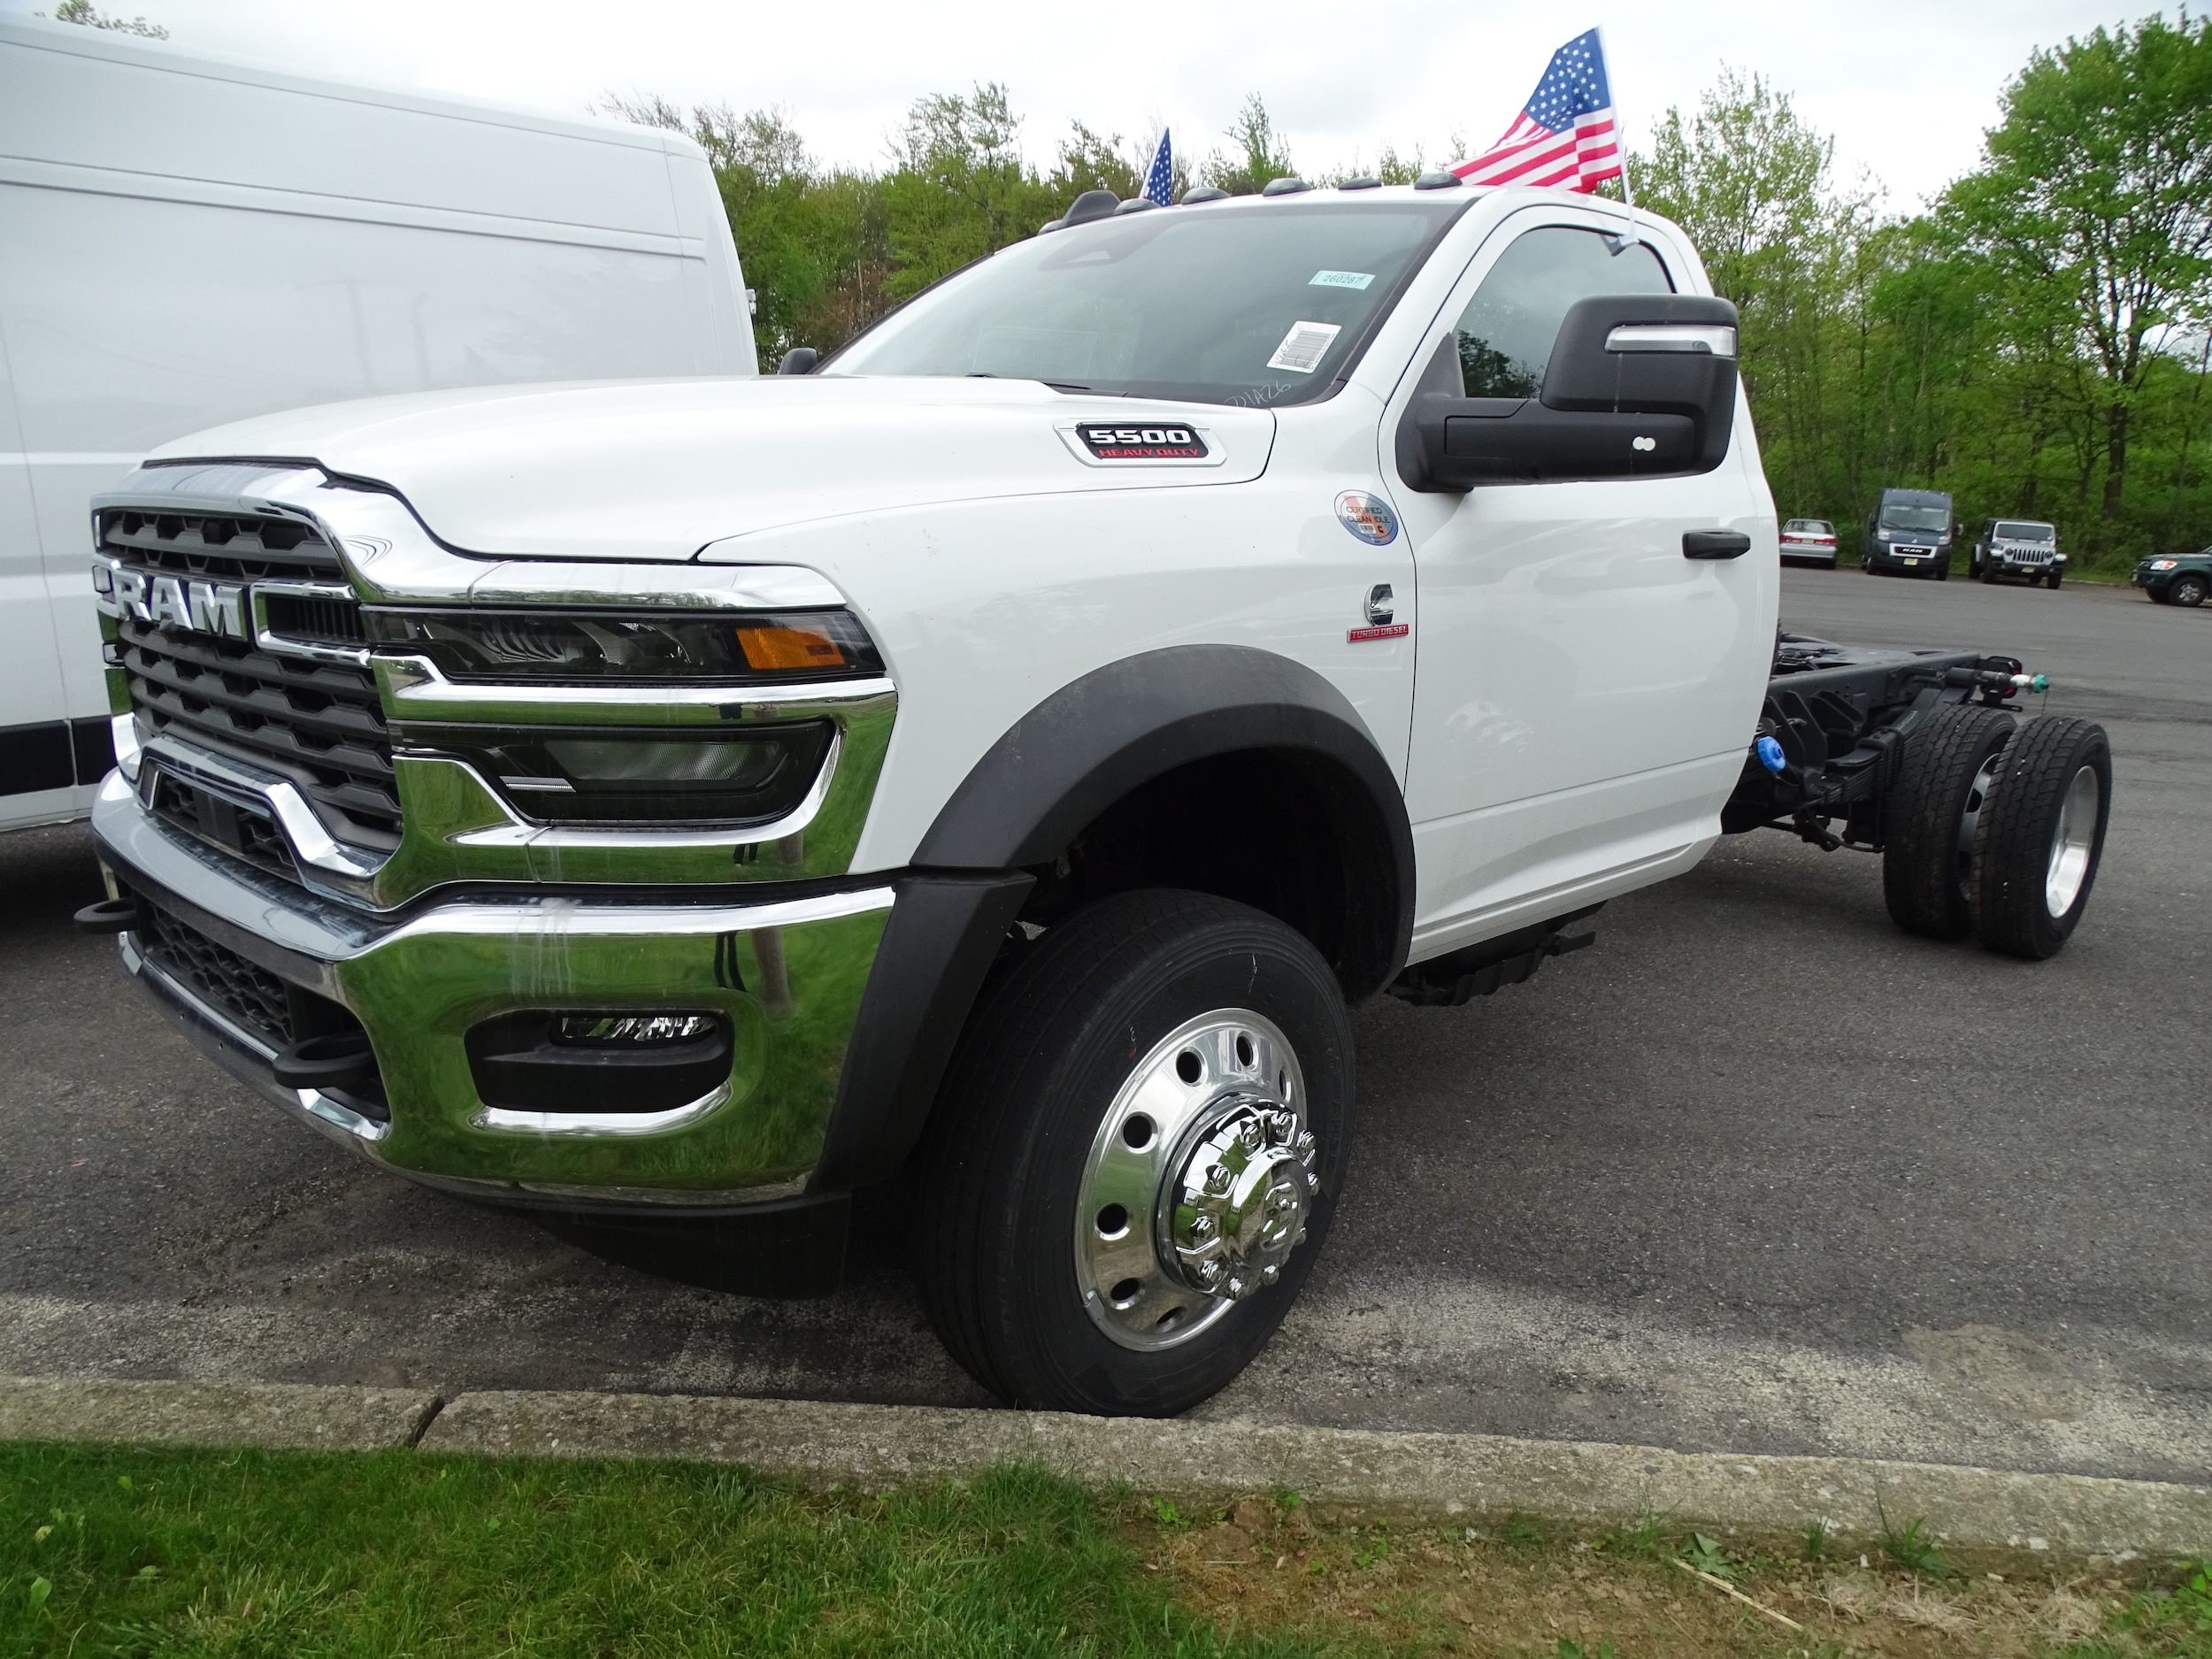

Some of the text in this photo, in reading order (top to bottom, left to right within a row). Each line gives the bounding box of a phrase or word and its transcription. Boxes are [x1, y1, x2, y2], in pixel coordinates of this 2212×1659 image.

[1322, 274, 1361, 285] 260287
[1087, 429, 1192, 445] 5500
[1098, 449, 1153, 457] HEAVY
[113, 569, 246, 639] RAM
[1352, 625, 1408, 639] TURBO DIESEL
